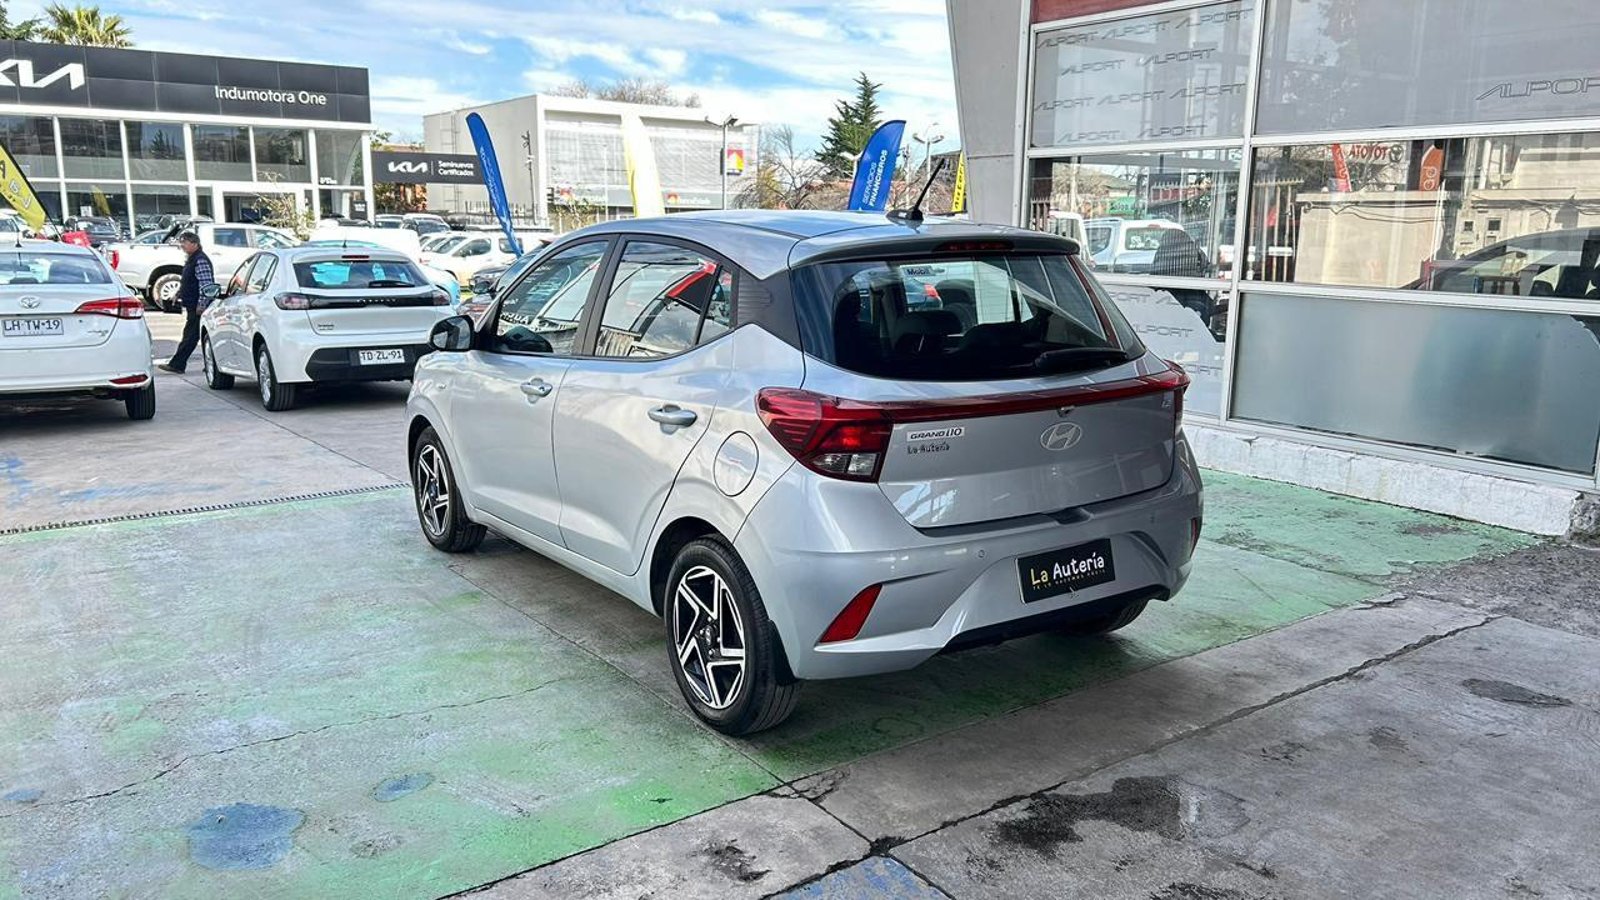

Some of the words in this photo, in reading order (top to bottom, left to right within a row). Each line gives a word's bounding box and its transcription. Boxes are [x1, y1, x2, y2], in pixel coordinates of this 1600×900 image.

[1101, 20, 1170, 39] ALPORT
[1175, 8, 1254, 29] ALPORT
[1061, 59, 1125, 75] ALPORT
[1143, 47, 1216, 66] ALPORT
[214, 85, 296, 103] Indumotora
[298, 91, 327, 105] One
[1097, 90, 1165, 106] ALPORT
[1169, 83, 1246, 99] ALPORT
[1475, 77, 1600, 101] ALPOR
[1137, 124, 1208, 138] ALPORT
[388, 161, 428, 173] KIA
[868, 149, 888, 207] FINANCIEROS
[862, 162, 877, 205] SERVICIOS
[1109, 291, 1151, 303] PORT
[910, 430, 945, 440] GRAND
[907, 444, 918, 455] La
[1030, 568, 1049, 585] La
[1053, 551, 1105, 580] Autería
